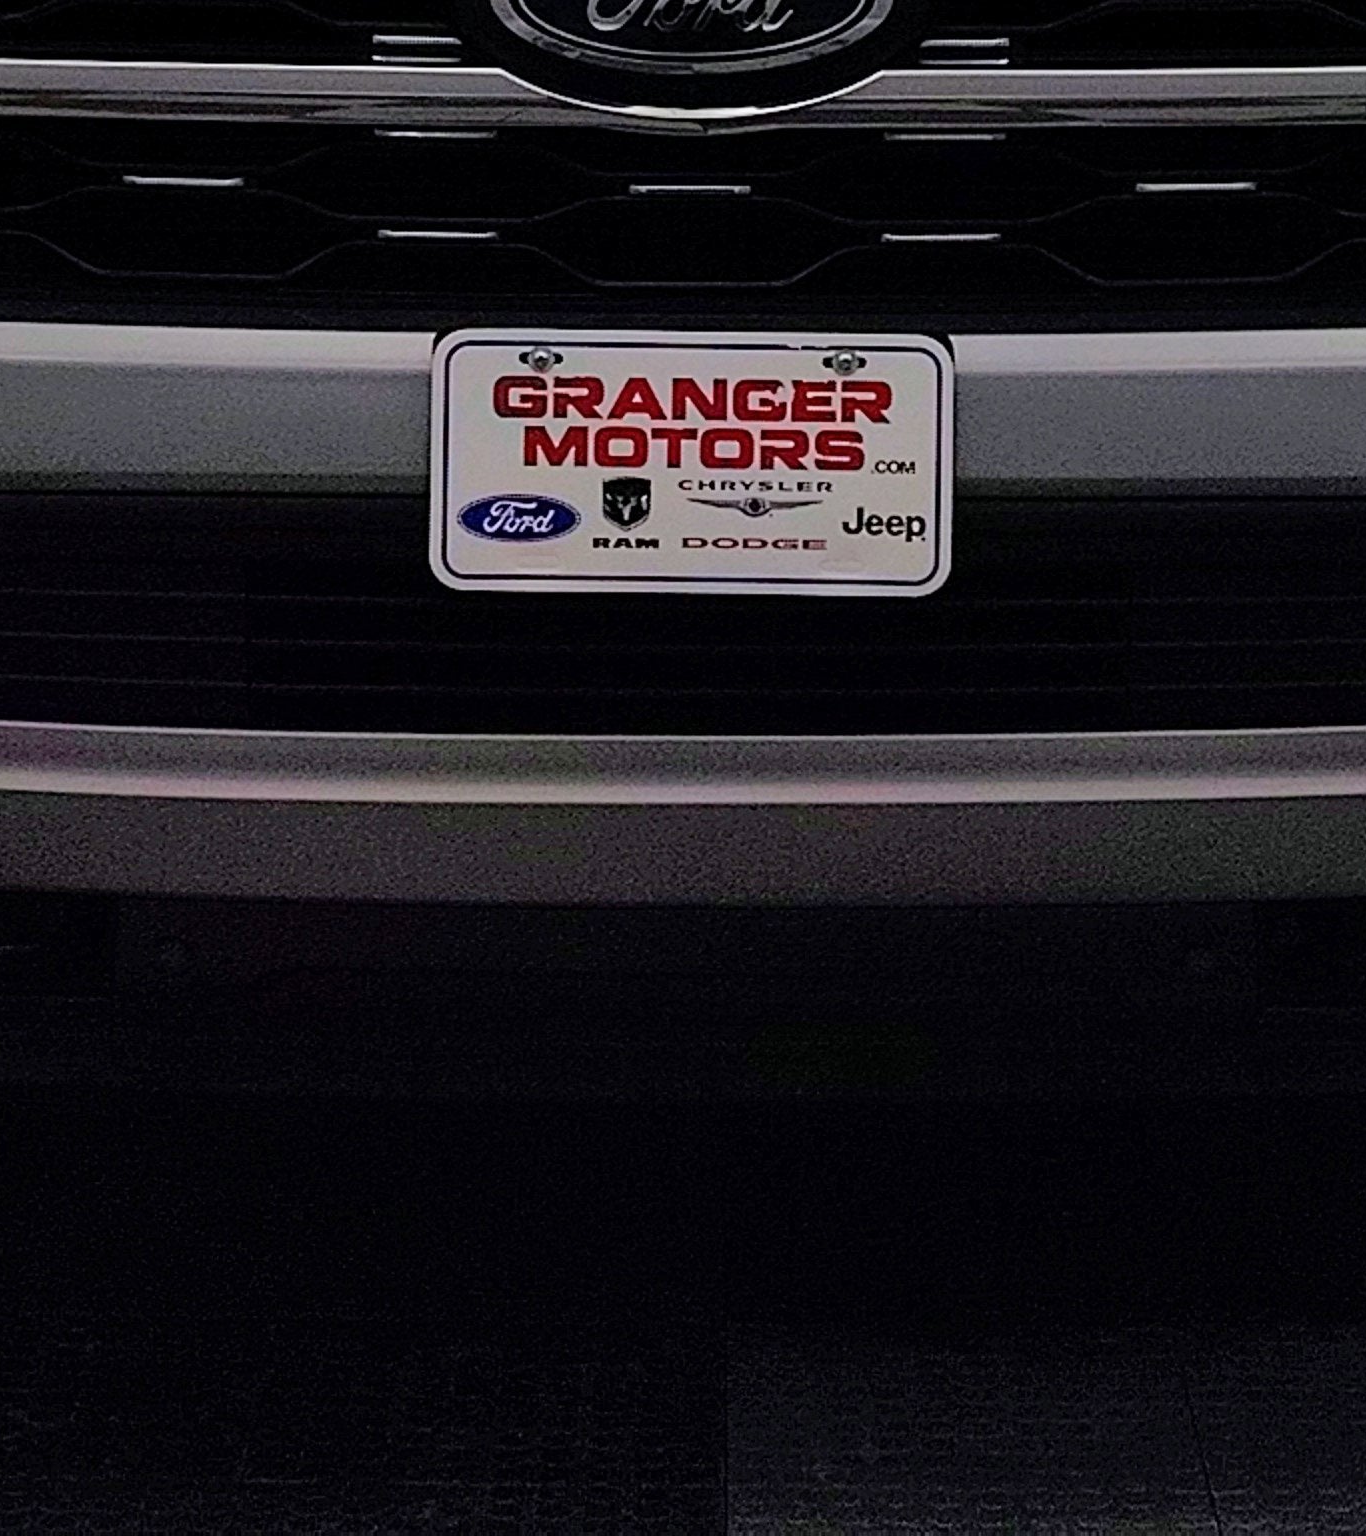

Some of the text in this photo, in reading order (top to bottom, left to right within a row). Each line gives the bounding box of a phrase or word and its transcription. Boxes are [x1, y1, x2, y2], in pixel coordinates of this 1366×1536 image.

[493, 375, 892, 423] GRANGER
[523, 425, 865, 470] MOTORS
[678, 479, 833, 493] CHRYSLER
[482, 500, 555, 533] Ford
[842, 507, 926, 542] Jeep
[592, 537, 660, 549] RAM
[682, 537, 828, 550] DODGE
